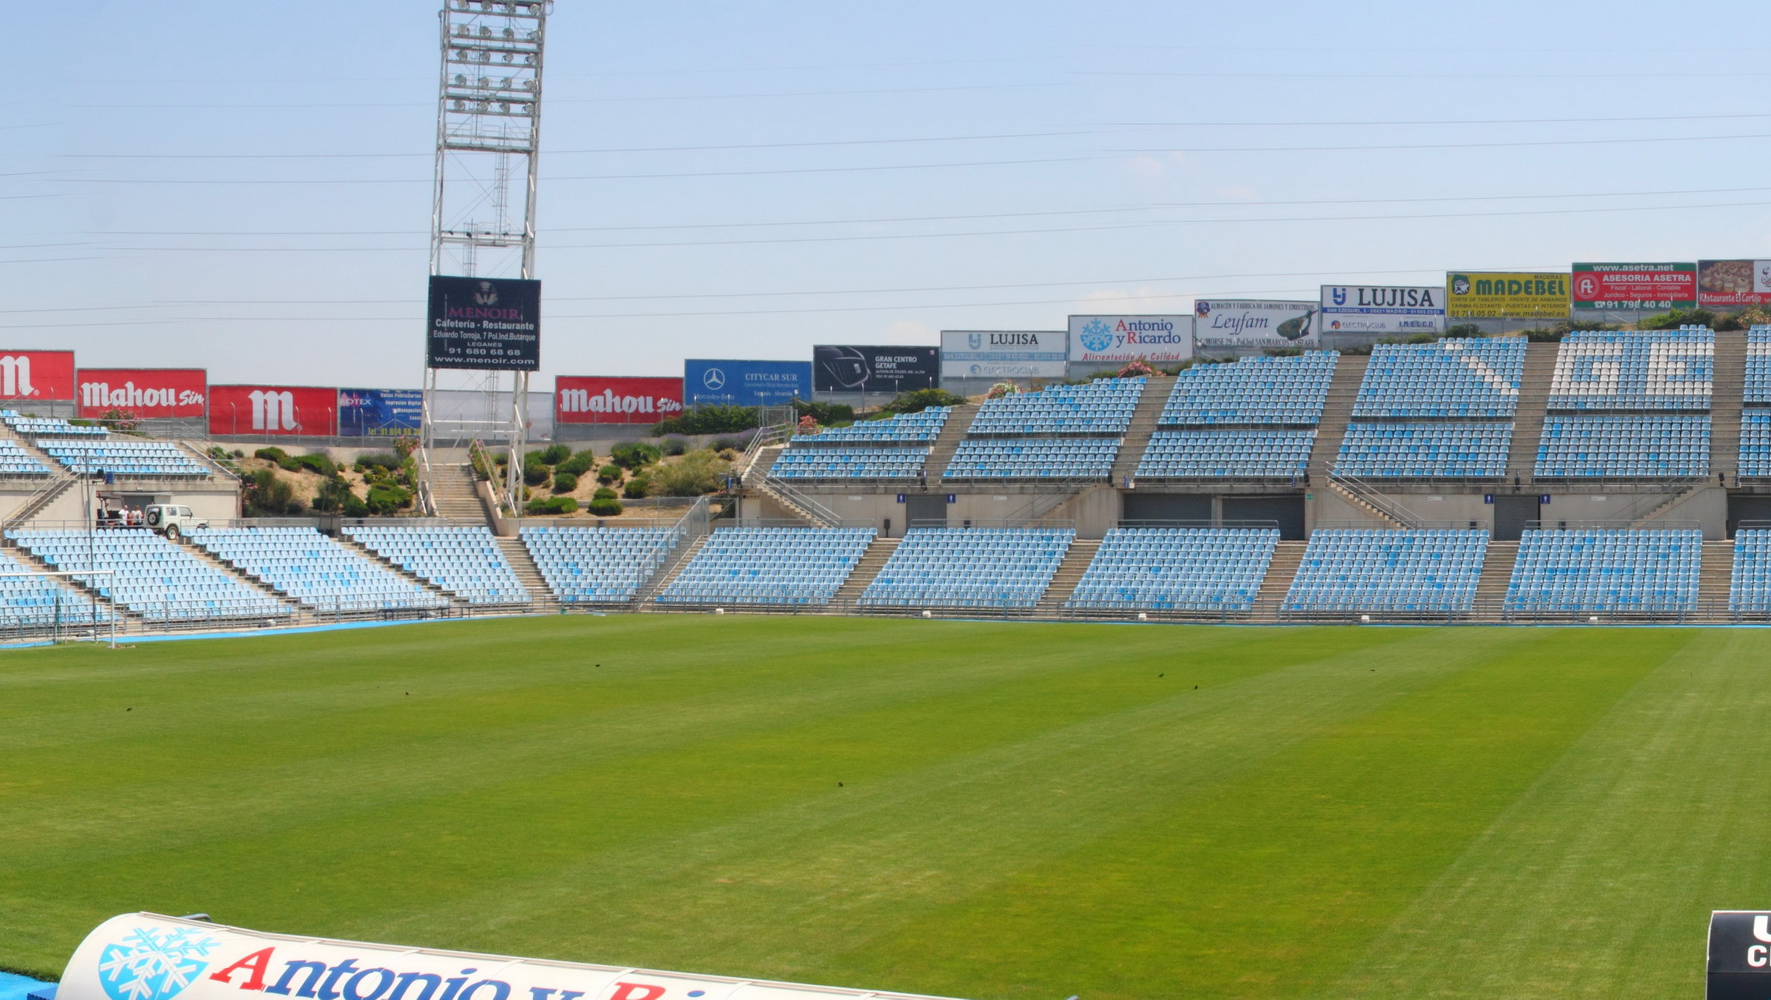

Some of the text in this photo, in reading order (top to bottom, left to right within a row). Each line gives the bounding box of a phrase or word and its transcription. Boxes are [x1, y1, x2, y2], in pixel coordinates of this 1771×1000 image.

[1592, 264, 1674, 272] www.asetra.net
[1602, 274, 1692, 282] ASESORIA ASETRA
[1476, 279, 1566, 296] MADEBEL
[1358, 288, 1434, 308] LUJISA
[1699, 293, 1735, 302] Restaurante
[1741, 293, 1762, 304] Cortijo
[448, 306, 520, 320] MENOIR
[482, 320, 534, 330] Restaurante
[1116, 318, 1174, 332] Antonio
[1211, 312, 1269, 336] Leyfam
[433, 330, 458, 338] Eduardo
[460, 331, 482, 340] Torroja,
[482, 332, 487, 340] 7
[989, 333, 1038, 346] LUJISA
[1116, 332, 1182, 348] y Ricardo
[434, 356, 535, 365] www.menoir.com
[1138, 352, 1148, 361] de
[1150, 352, 1180, 361] Calidad
[744, 373, 798, 382] CITYCAR SUR
[80, 381, 205, 408] Mahou Sin
[560, 388, 682, 414] Mahou Sin
